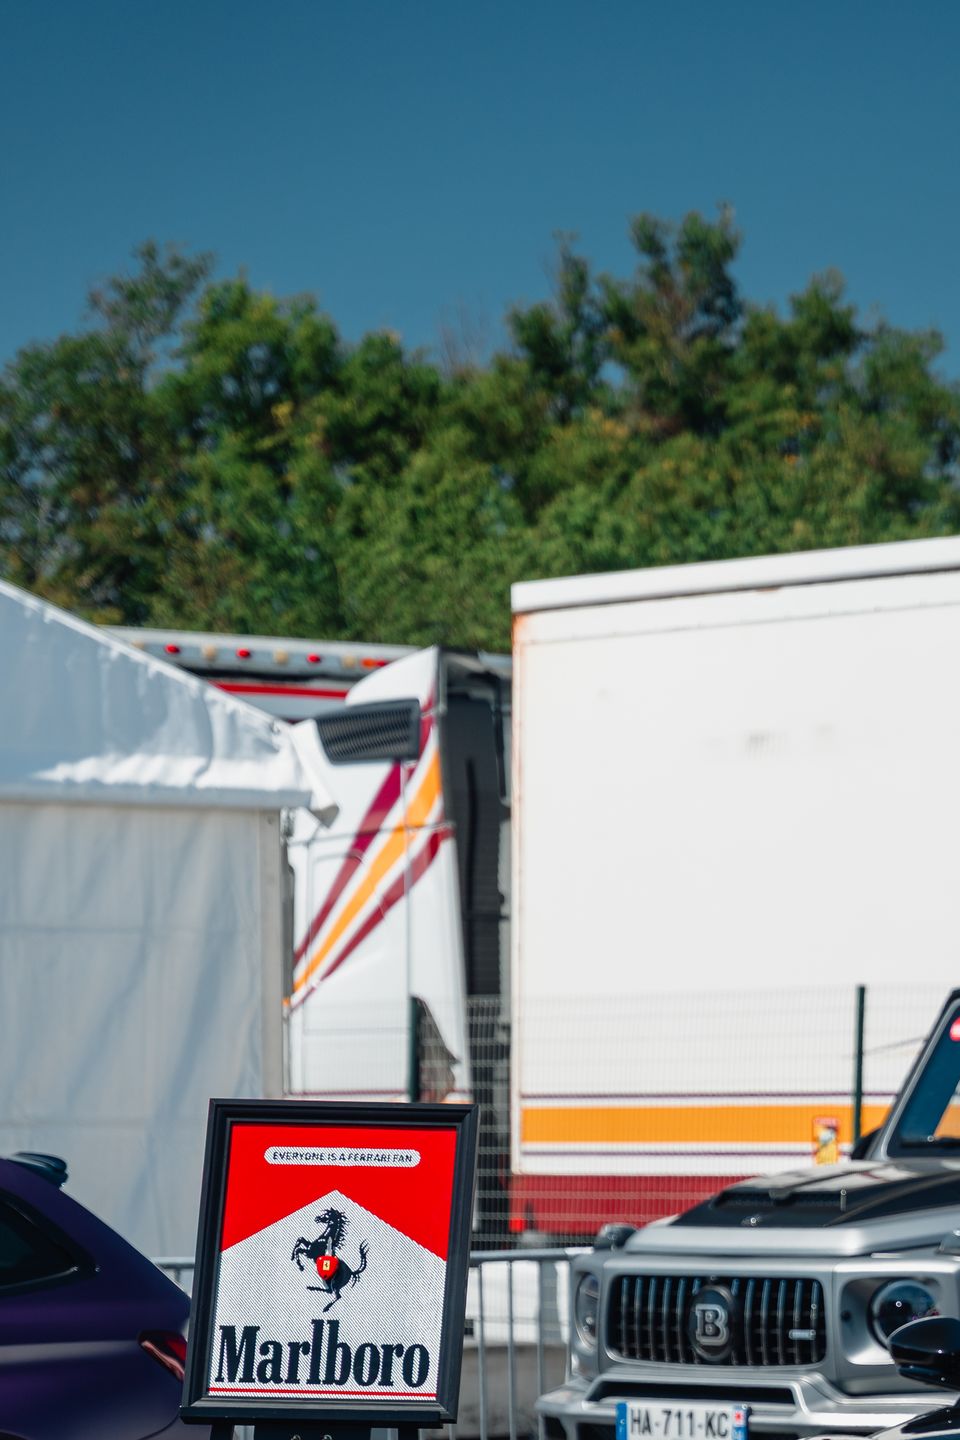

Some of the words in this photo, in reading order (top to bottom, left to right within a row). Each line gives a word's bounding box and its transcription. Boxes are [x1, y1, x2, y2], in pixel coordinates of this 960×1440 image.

[272, 1151, 324, 1161] EVERYONE
[327, 1152, 337, 1161] IS
[339, 1152, 346, 1162] A
[347, 1152, 391, 1162] FERRARI
[392, 1153, 412, 1163] FAN
[695, 1303, 730, 1346] B
[215, 1319, 430, 1388] Marlboro
[630, 1408, 728, 1439] HA-711-KC
